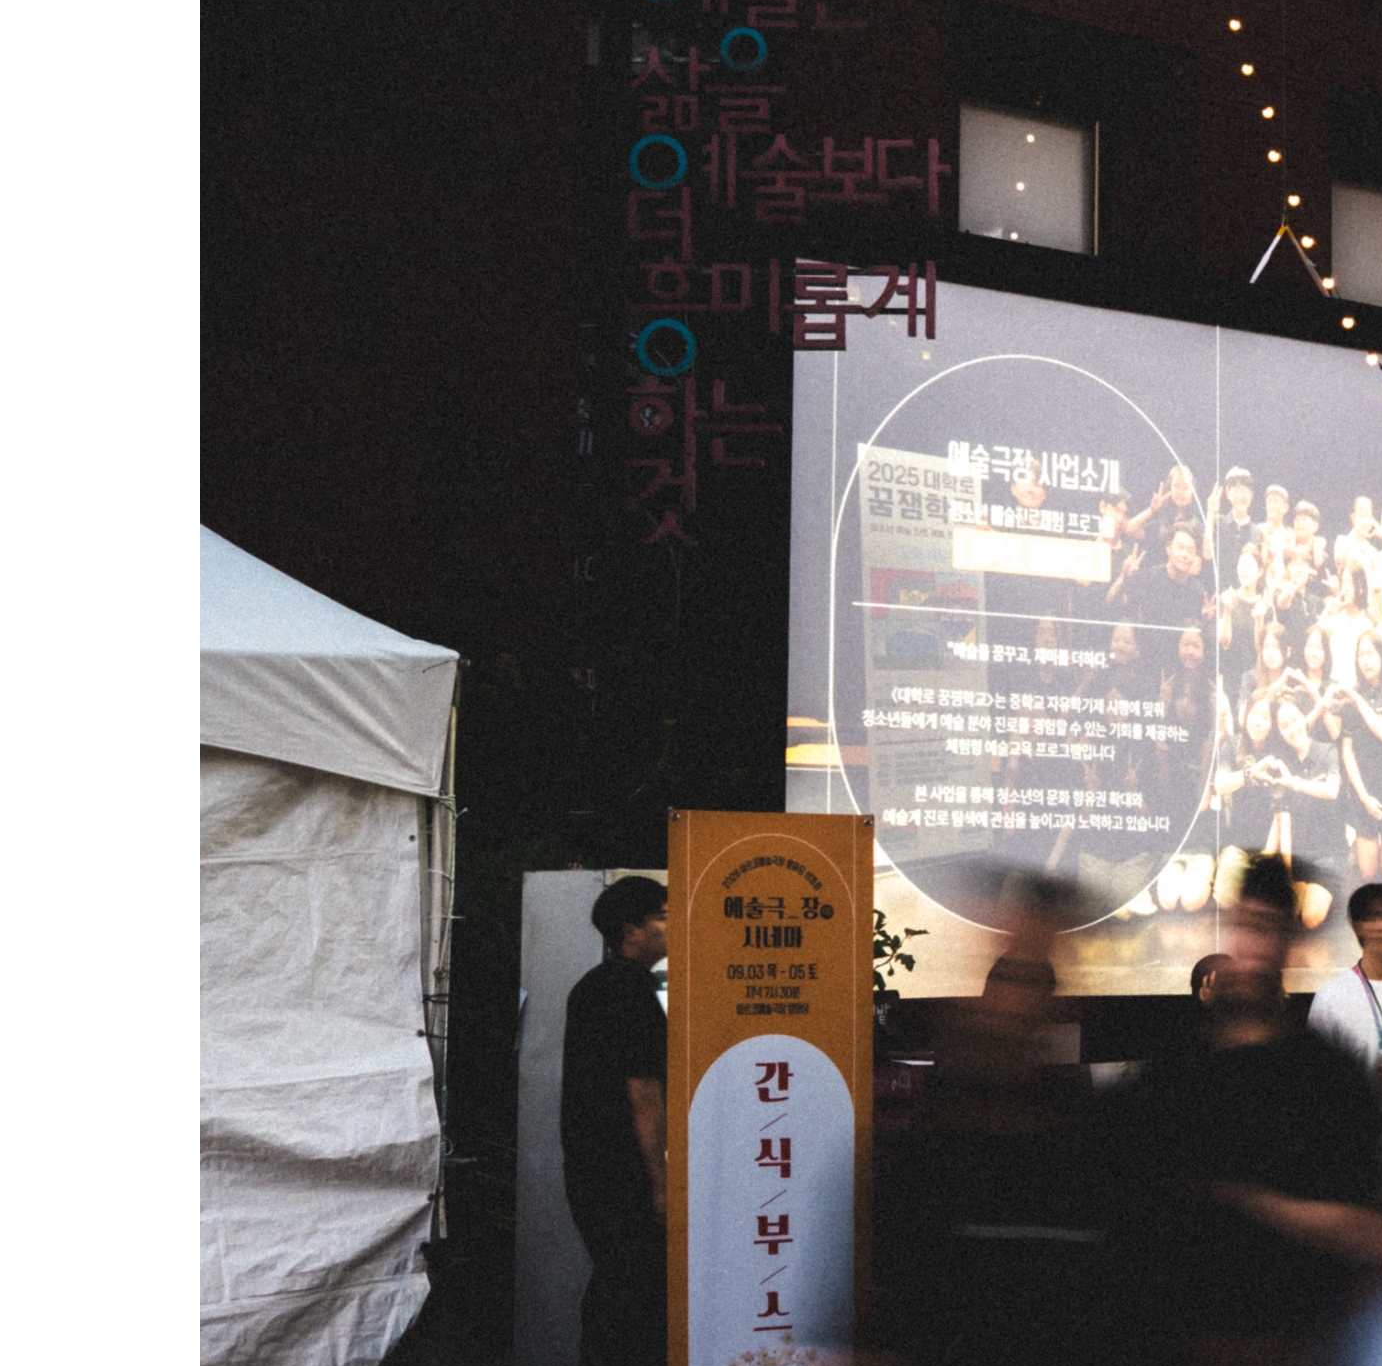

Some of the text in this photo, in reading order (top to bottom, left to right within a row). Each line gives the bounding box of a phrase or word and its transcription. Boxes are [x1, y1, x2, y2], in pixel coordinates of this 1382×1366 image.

[631, 27, 787, 135] 삶을
[629, 134, 952, 225] 예술보다
[627, 188, 692, 262] 더
[628, 256, 937, 377] 흥미롭게
[628, 374, 783, 467] 하는
[868, 460, 920, 487] 2025
[949, 439, 1120, 494] 예술극장 사업소개
[630, 458, 698, 544] 것
[1009, 692, 1045, 711] 중학교
[1047, 695, 1105, 715] 자유학기제
[940, 713, 965, 732] 예술
[994, 716, 1030, 735] 진로를
[1070, 720, 1082, 737] 수
[1084, 720, 1107, 738] 있는
[1109, 722, 1143, 740] 기회를
[1145, 724, 1189, 743] 제공하는
[985, 740, 1033, 759] 예술교육
[1036, 741, 1116, 762] 프로그램입니다
[915, 785, 929, 802] 본
[931, 785, 967, 804] 사업을
[996, 787, 1044, 806] 청소년의
[1046, 789, 1070, 806] 문화
[924, 808, 949, 827] 진로
[1126, 815, 1170, 832] 있습니다
[742, 925, 804, 948] 시네마
[727, 963, 765, 980] 09.03
[789, 964, 805, 980] 05
